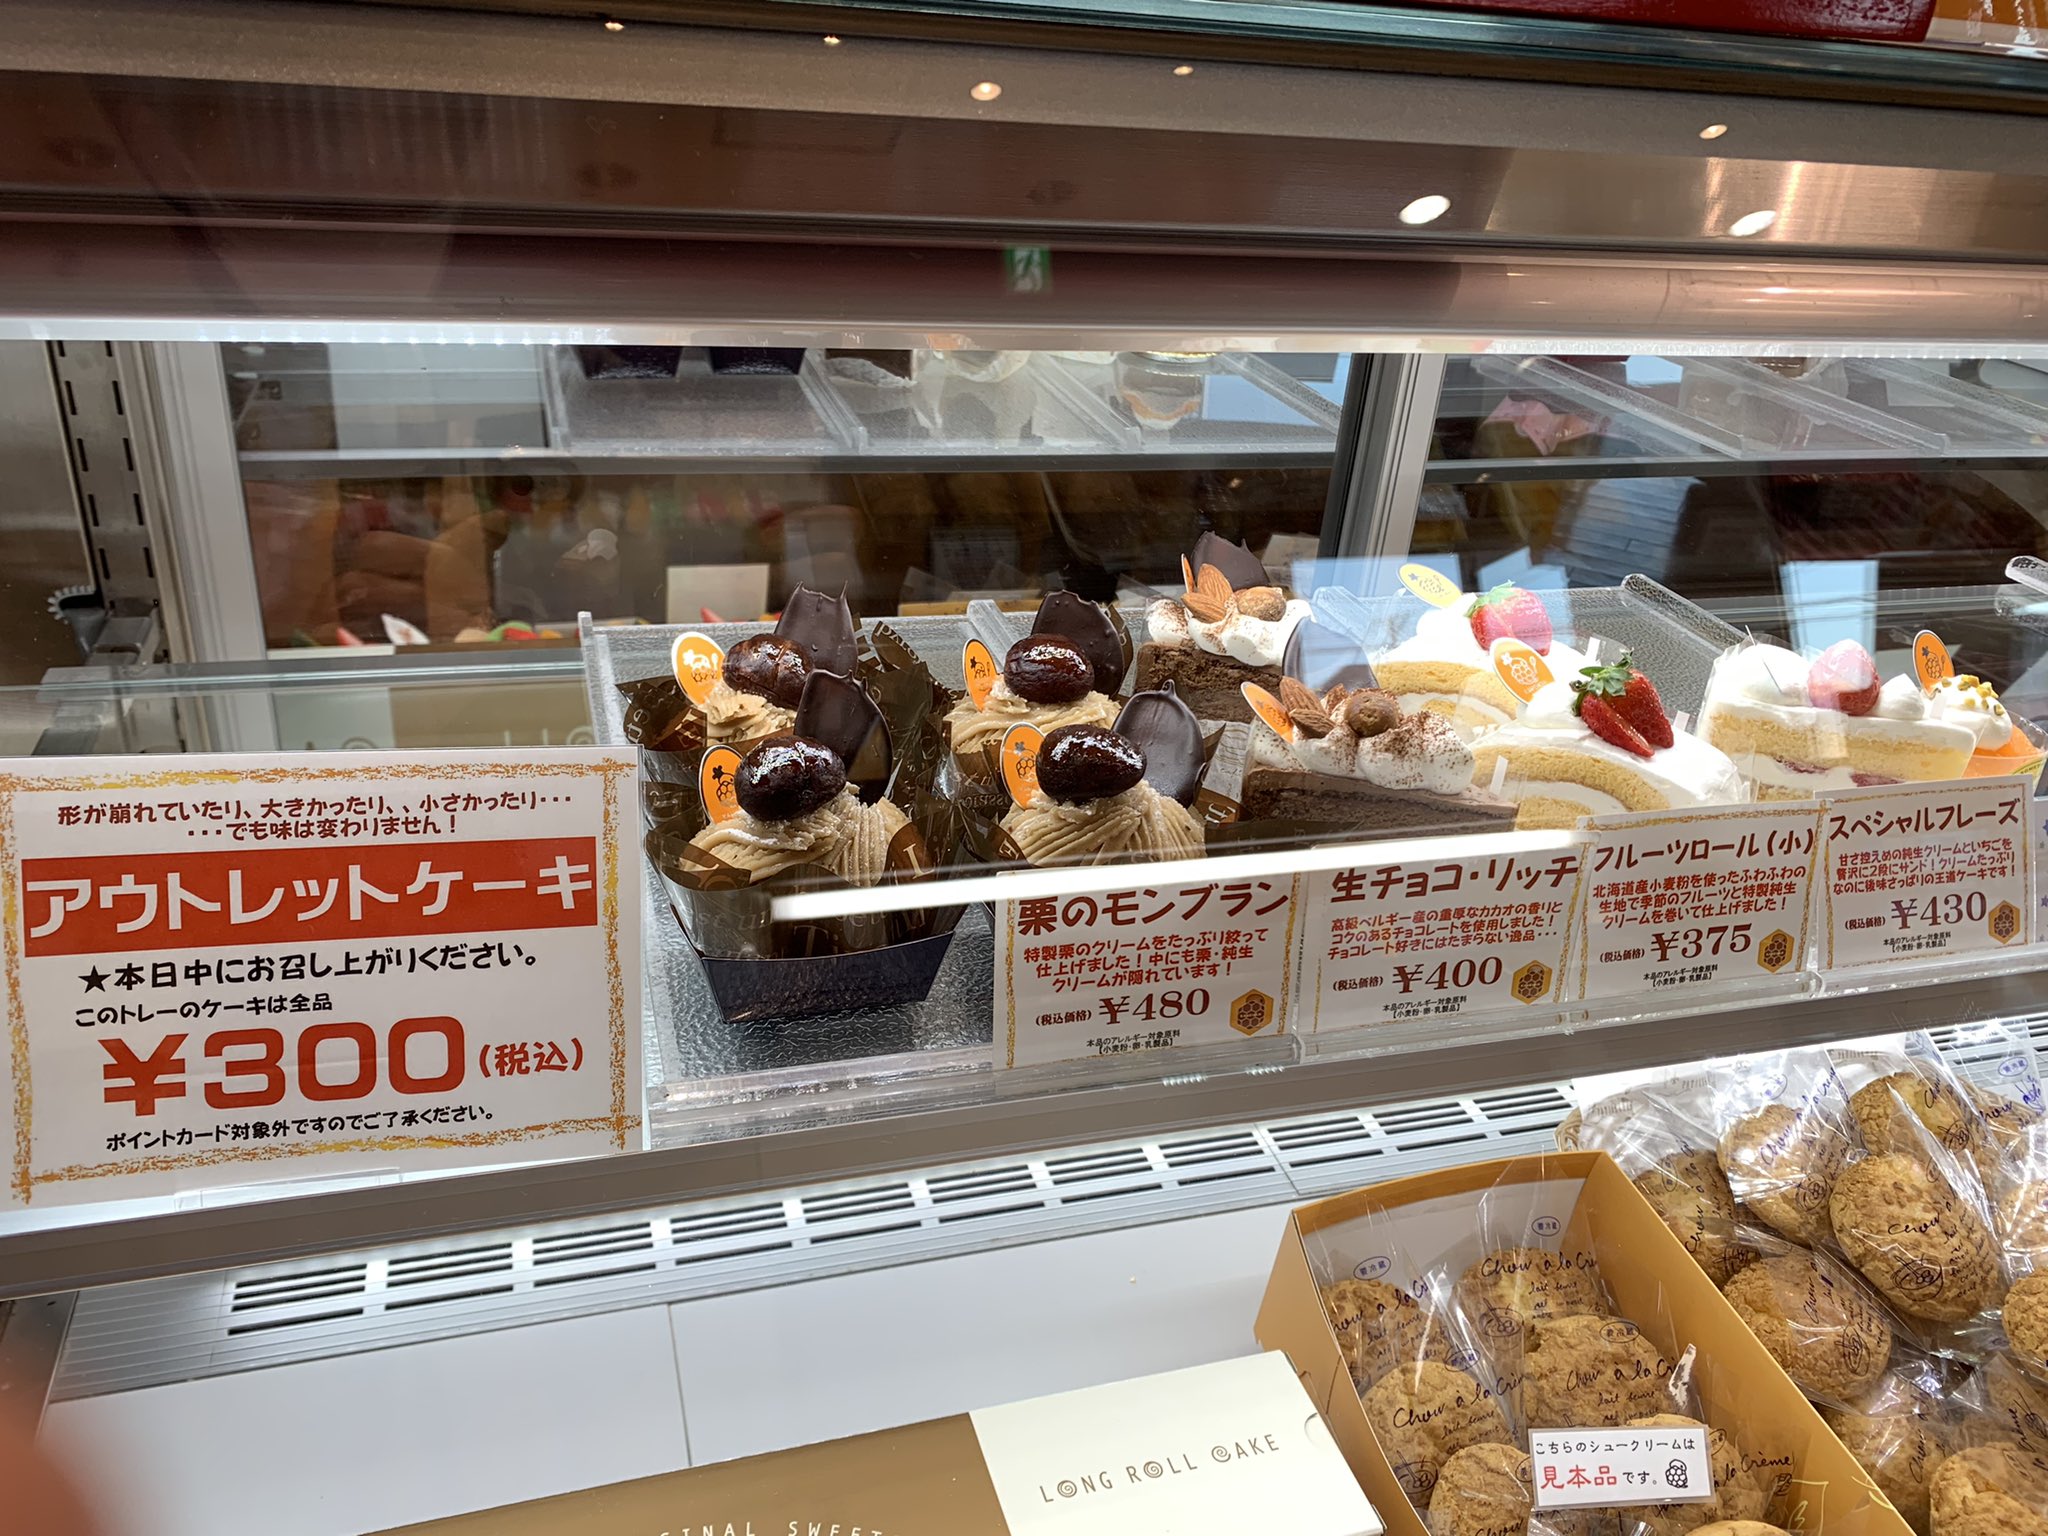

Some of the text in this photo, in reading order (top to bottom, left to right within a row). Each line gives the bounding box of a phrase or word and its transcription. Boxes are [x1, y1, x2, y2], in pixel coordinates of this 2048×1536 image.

[1829, 798, 2021, 841] スペシャルフレーズ
[1594, 827, 1814, 873] フルーツロール(小)
[1839, 838, 2012, 867] 甘さ控えめの純生クリームといちごを
[26, 855, 593, 938] アウトレットケーキ
[1330, 856, 1579, 903] 生チョコ・リッチ
[1592, 865, 1806, 899] 北海道産小麦粉を使ったふわふわの
[1833, 865, 2016, 895] なのに後味さっぱりの王道ケーキです！
[1018, 881, 1289, 936] 栗のモンブラン
[1599, 881, 1797, 914] 生地で季節のフルーツと特製純生
[1602, 896, 1787, 930] クリームを巻いて仕上げました！
[1891, 891, 1987, 930] ¥430
[1331, 901, 1563, 932] 高級ベルギー産の重厚なカカオの香りと
[1332, 915, 1553, 945] コクのあるチョコレートを使用しました！
[1024, 928, 1269, 963] 特製栗のクリームをたっぷり絞って
[1650, 923, 1752, 962] ¥375
[1036, 945, 1254, 979] 仕上げました！中にも栗・純生
[1052, 963, 1232, 993] クリームが隠れています！
[1392, 956, 1502, 994] ¥400
[75, 992, 333, 1028] このトレーのケーキは全品
[1099, 988, 1210, 1025] ¥480
[1086, 1029, 1181, 1048] 本品のアレルギー対象原料
[99, 1016, 584, 1117] ¥300 (税込)
[105, 1104, 494, 1152] ポイントカード対象外ですのでご了承ください。
[1536, 1437, 1696, 1455] こちらのシュークリームは
[1039, 1434, 1280, 1503] LONG ROLL CAKE
[1540, 1464, 1659, 1490] 見本品です。
